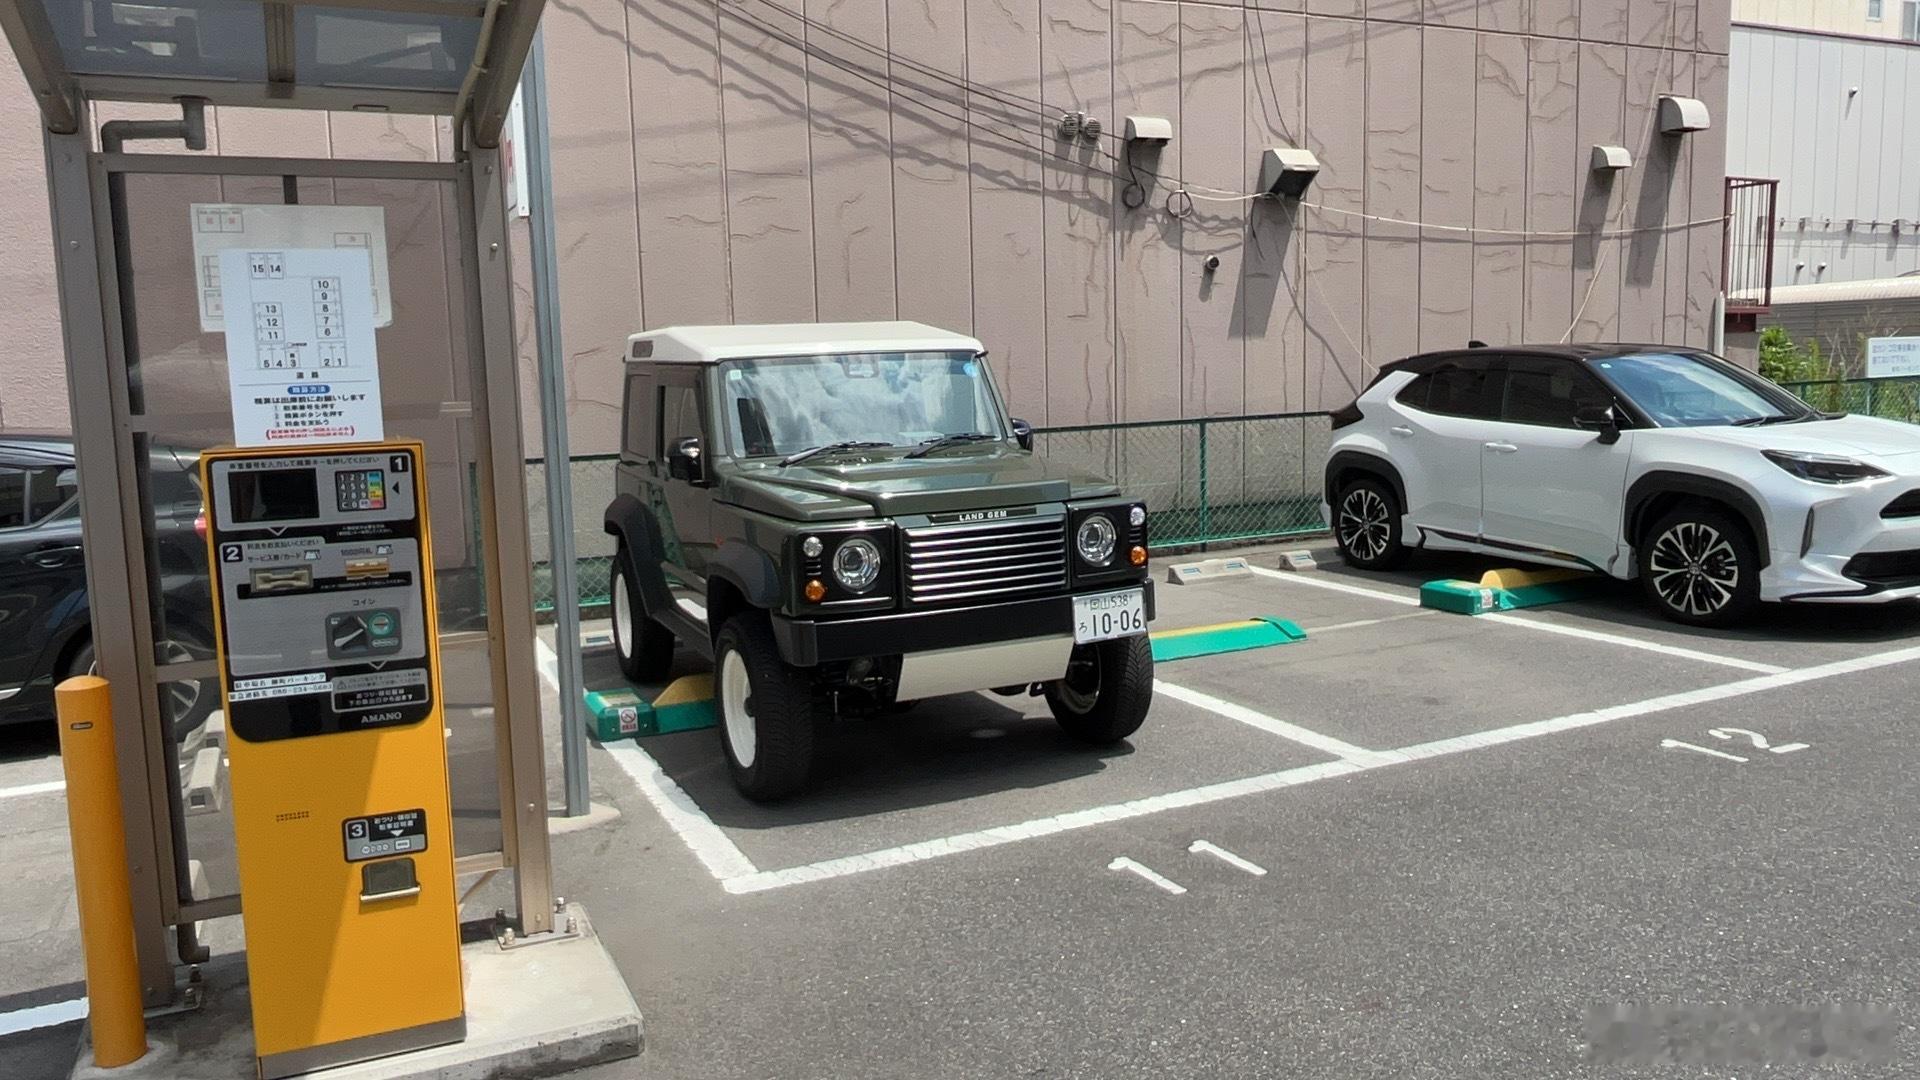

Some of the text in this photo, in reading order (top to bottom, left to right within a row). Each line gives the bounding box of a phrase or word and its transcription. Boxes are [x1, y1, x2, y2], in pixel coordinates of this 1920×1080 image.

[252, 264, 281, 273] 15 14
[317, 280, 329, 289] 10
[321, 291, 328, 300] 9
[265, 305, 277, 313] 13
[322, 304, 329, 312] 8
[266, 318, 278, 327] 12
[323, 316, 329, 325] 7
[267, 331, 278, 339] 11
[324, 328, 331, 336] 6
[263, 359, 297, 368] 5 4 3
[323, 359, 330, 367] 2
[392, 457, 403, 471] 1
[959, 510, 1007, 521] LAND GEM
[226, 548, 239, 560] 2
[352, 598, 375, 606] コイン
[1079, 607, 1141, 637] ろ 10-06
[361, 711, 402, 724] AMANO
[1661, 727, 1811, 763] 12
[351, 824, 364, 837] 3
[1107, 839, 1268, 895] 11
